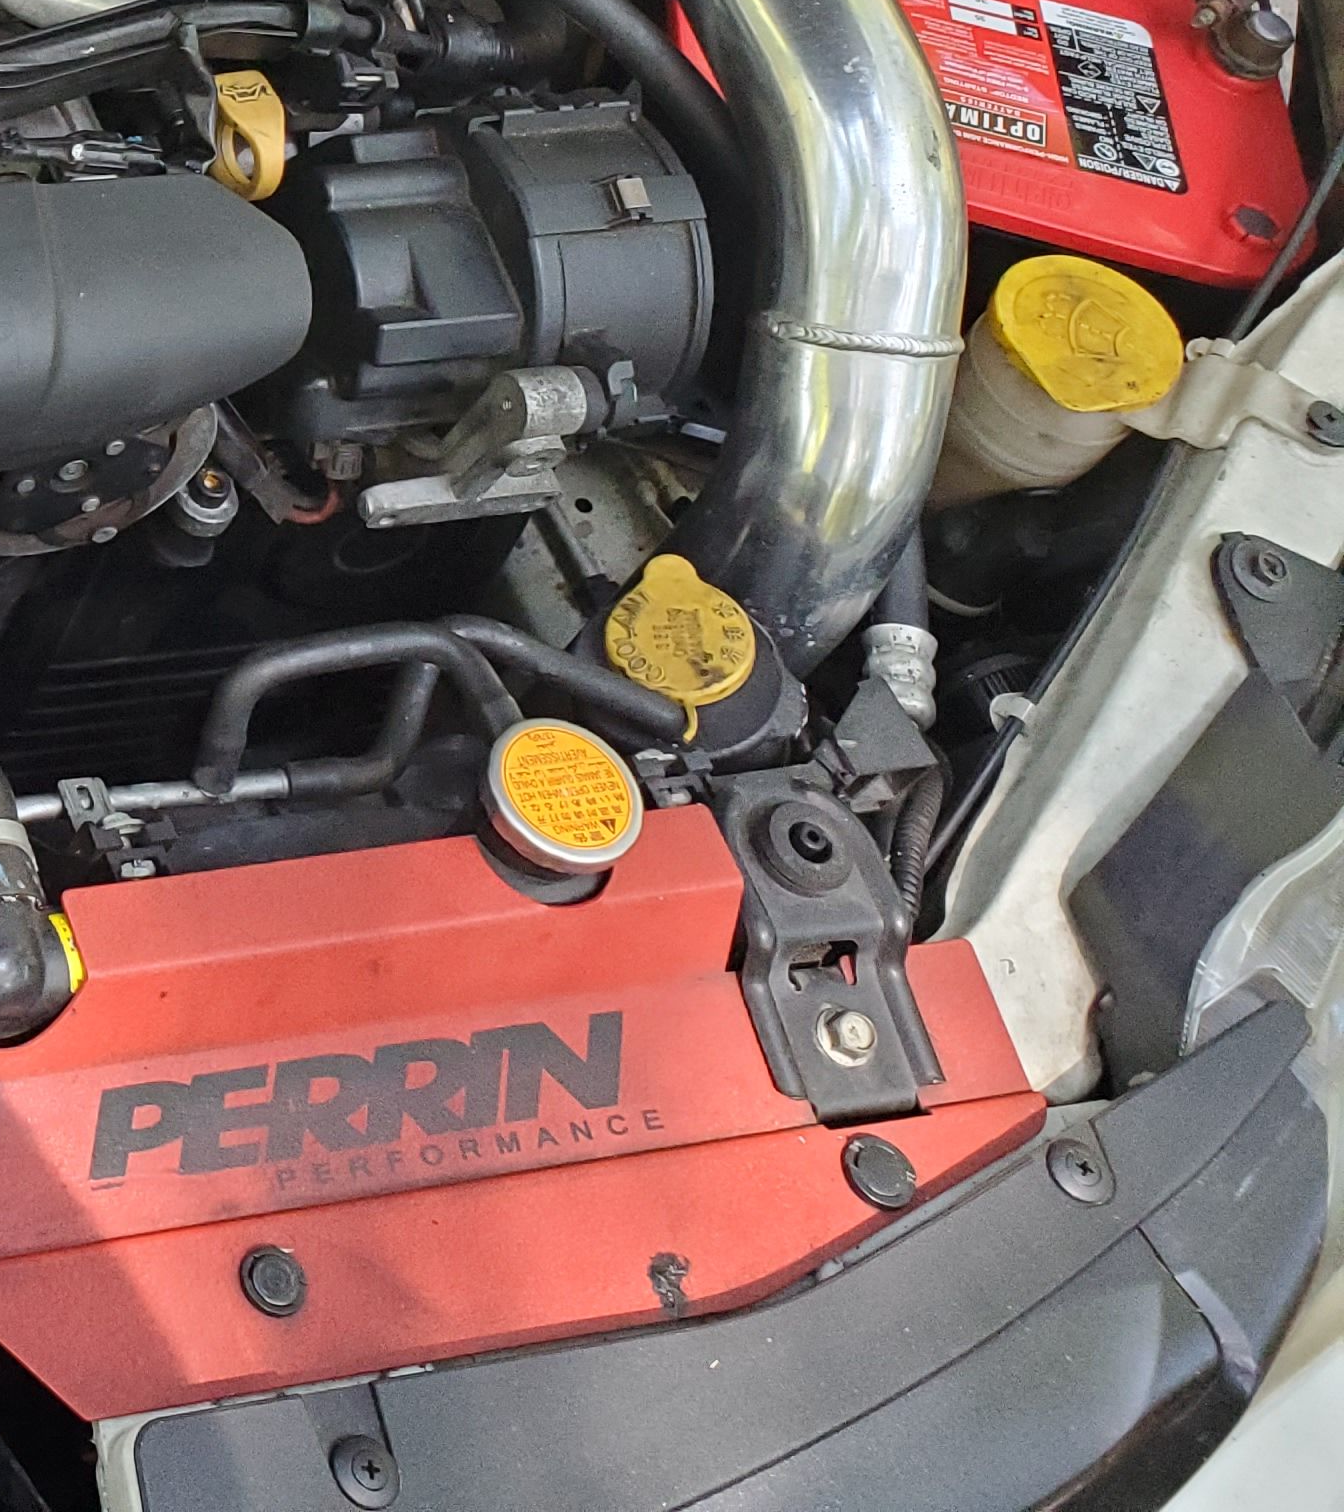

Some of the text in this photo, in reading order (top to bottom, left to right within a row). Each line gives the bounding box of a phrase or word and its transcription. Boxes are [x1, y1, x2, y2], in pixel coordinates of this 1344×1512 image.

[943, 76, 986, 92] STARTING
[960, 95, 1020, 116] BATTERIES
[945, 102, 1041, 140] OPTIMA
[1079, 159, 1165, 186] DANGER/POISON
[612, 590, 667, 684] COOLANT
[517, 748, 587, 766] AVERTISSEMENT
[537, 788, 563, 799] WHEN
[567, 784, 589, 794] OPEN
[591, 779, 620, 792] NEVER
[553, 820, 600, 834] WARNING
[88, 1010, 625, 1182] PERRIN
[274, 1108, 665, 1191] PERFORMANCE
